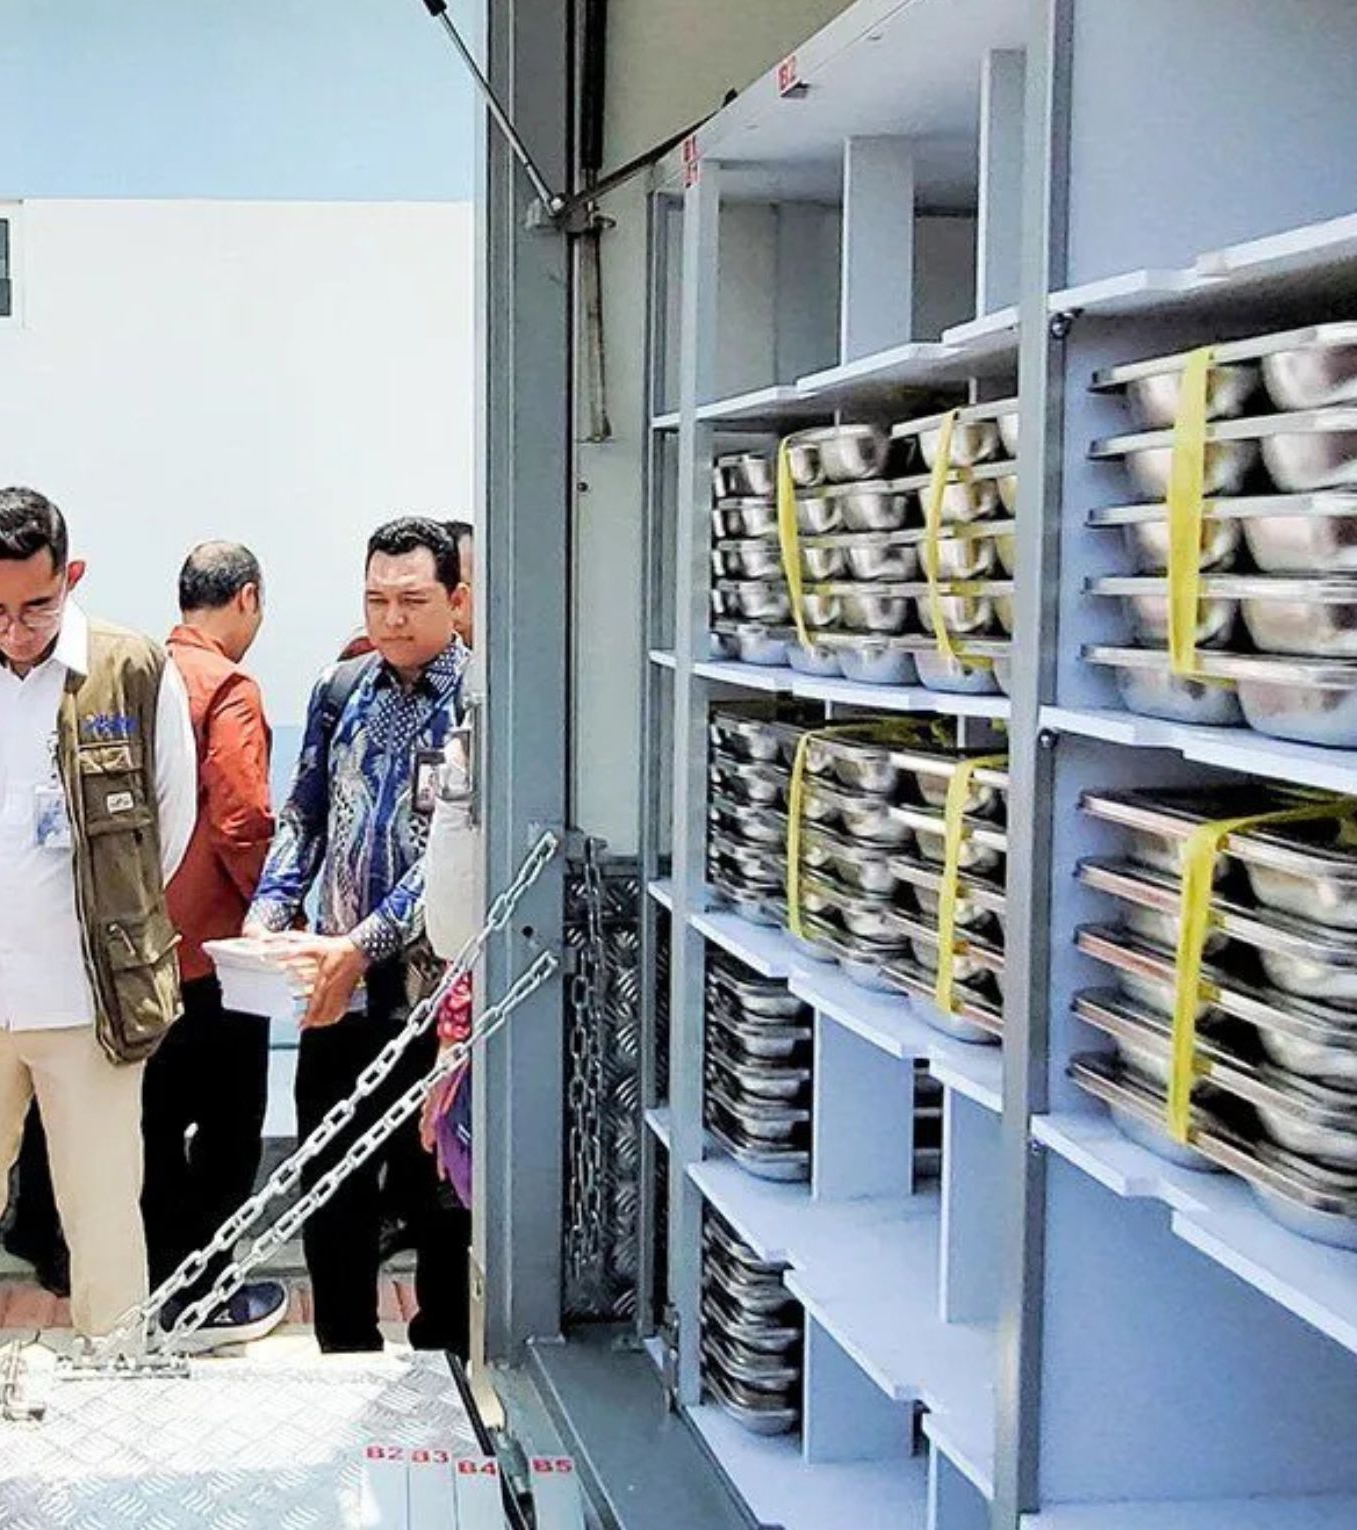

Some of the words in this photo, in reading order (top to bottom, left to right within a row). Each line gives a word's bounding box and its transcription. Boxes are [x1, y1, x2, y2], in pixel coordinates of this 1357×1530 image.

[366, 1446, 403, 1460] B2
[458, 1460, 496, 1476] B4
[532, 1459, 572, 1472] B5
